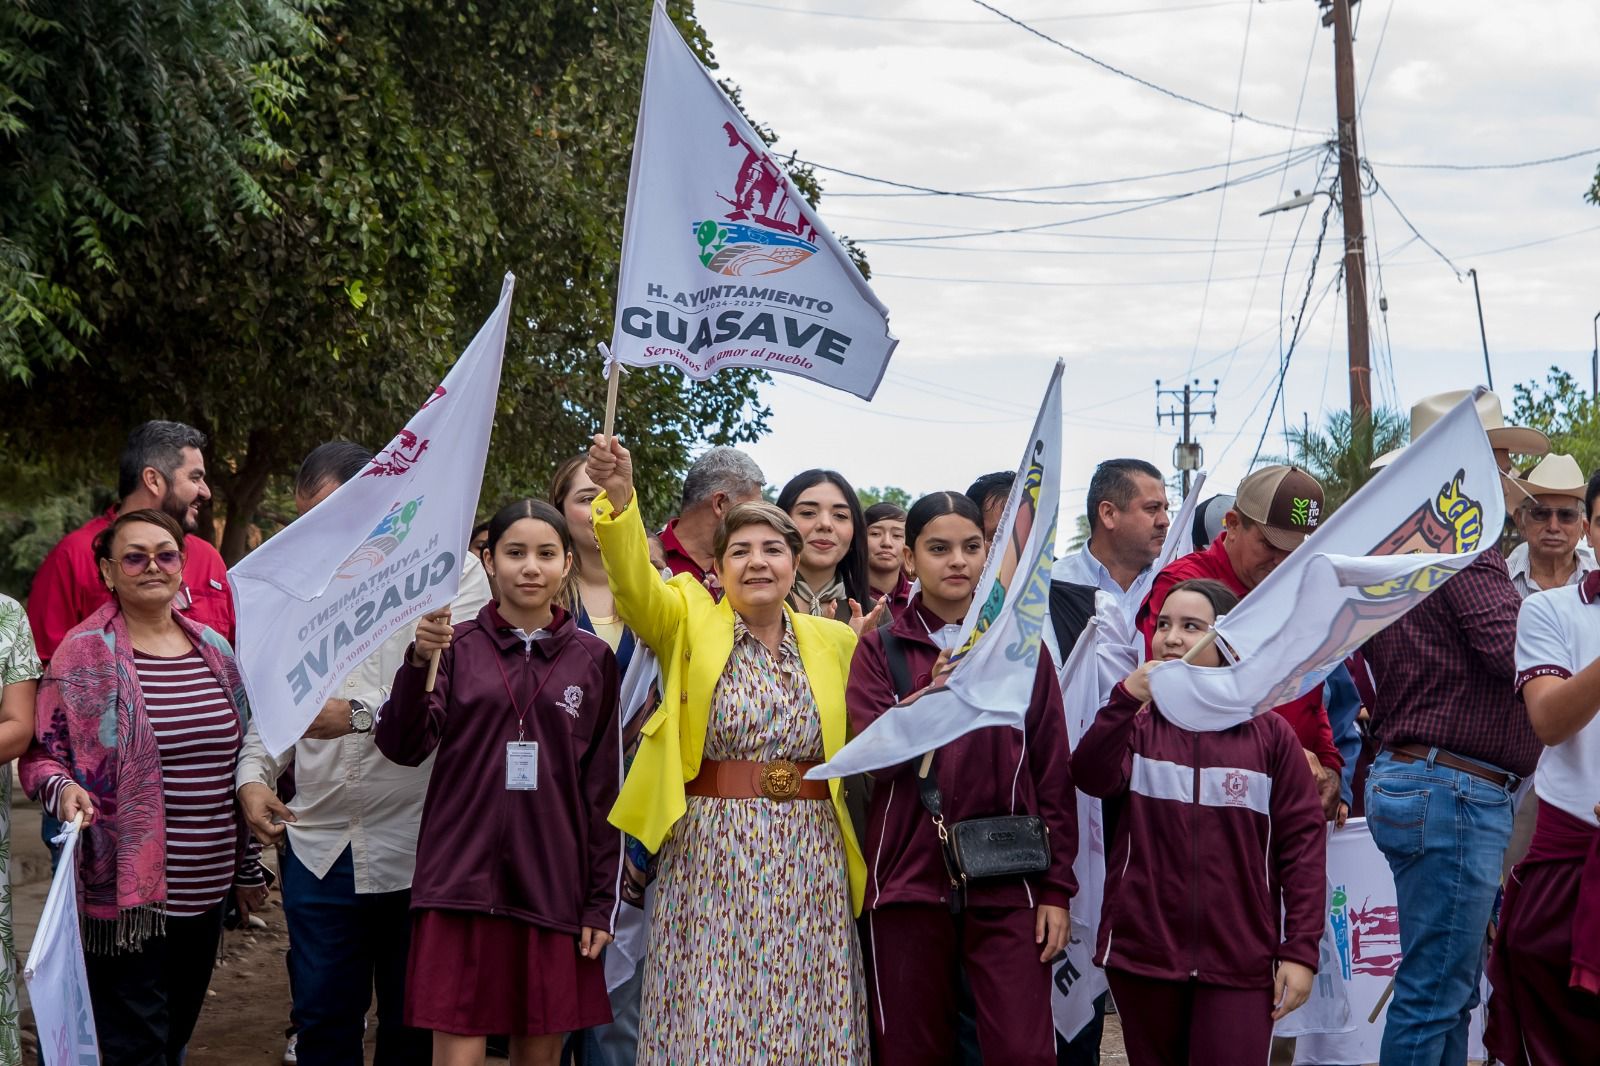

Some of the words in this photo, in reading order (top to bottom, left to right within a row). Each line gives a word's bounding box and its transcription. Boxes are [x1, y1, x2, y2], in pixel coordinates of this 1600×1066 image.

[647, 282, 669, 299] H.
[673, 285, 833, 314] AYUNTAMIENTO
[705, 300, 762, 311] 2024-2027
[621, 306, 852, 365] GUASAVE
[643, 346, 701, 372] Servimos
[704, 355, 717, 371] con
[716, 348, 749, 361] amor
[750, 347, 766, 358] al
[765, 351, 813, 369] pueblo
